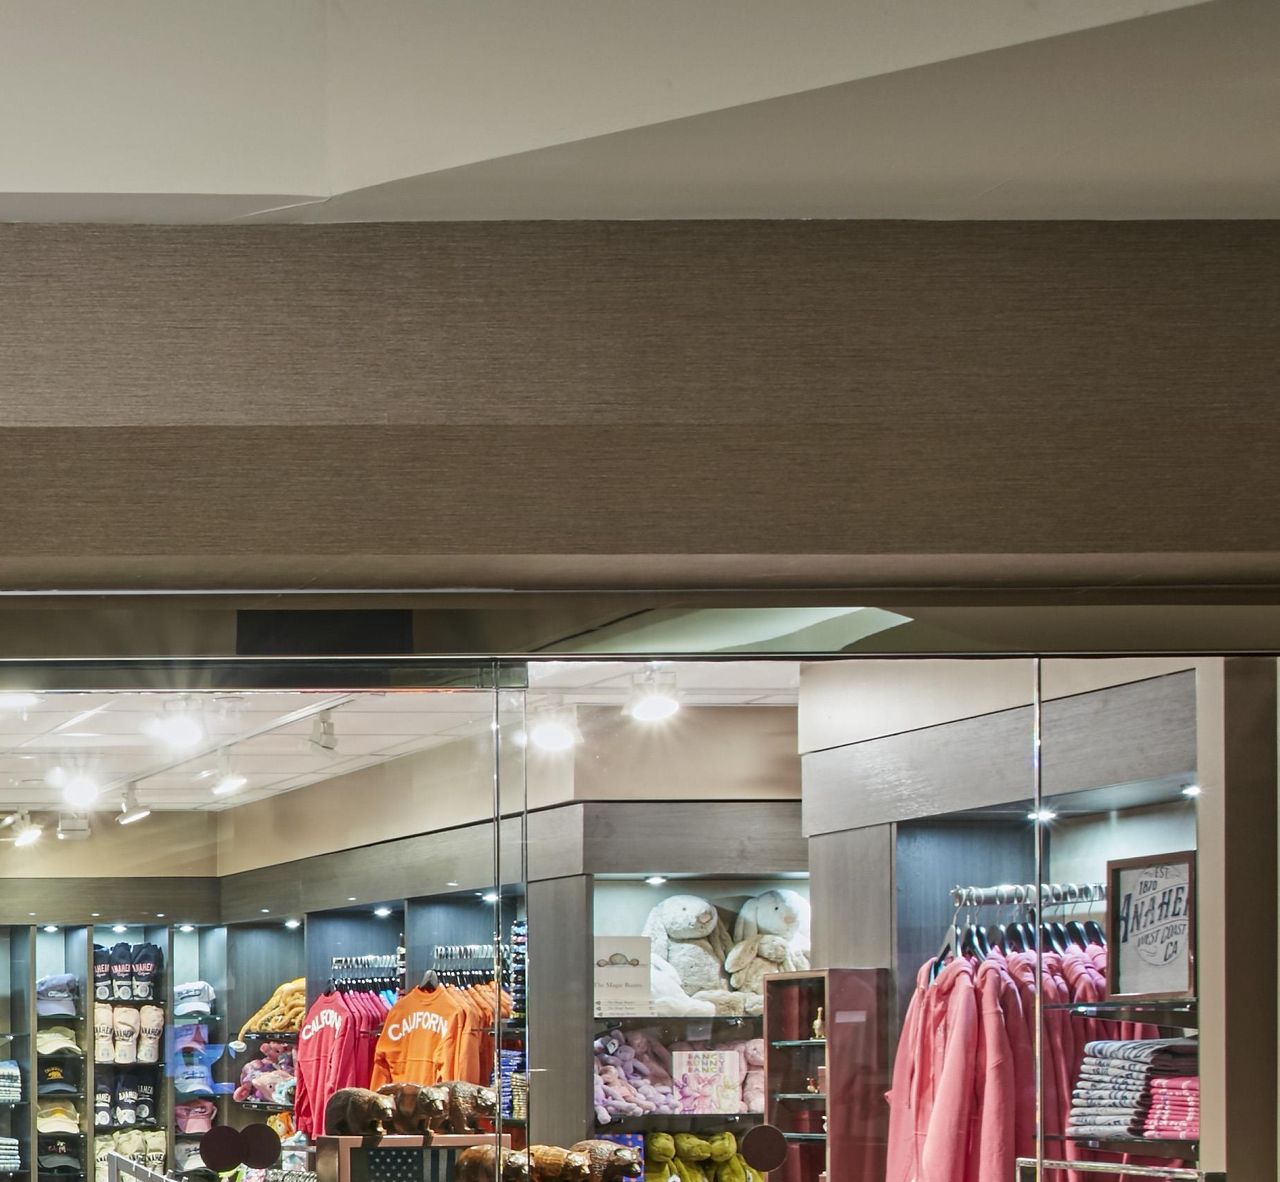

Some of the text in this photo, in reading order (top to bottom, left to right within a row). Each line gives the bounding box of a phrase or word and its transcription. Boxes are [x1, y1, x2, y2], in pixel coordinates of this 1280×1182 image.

[1137, 924, 1186, 948] WEST COAST
[1163, 941, 1178, 962] CA
